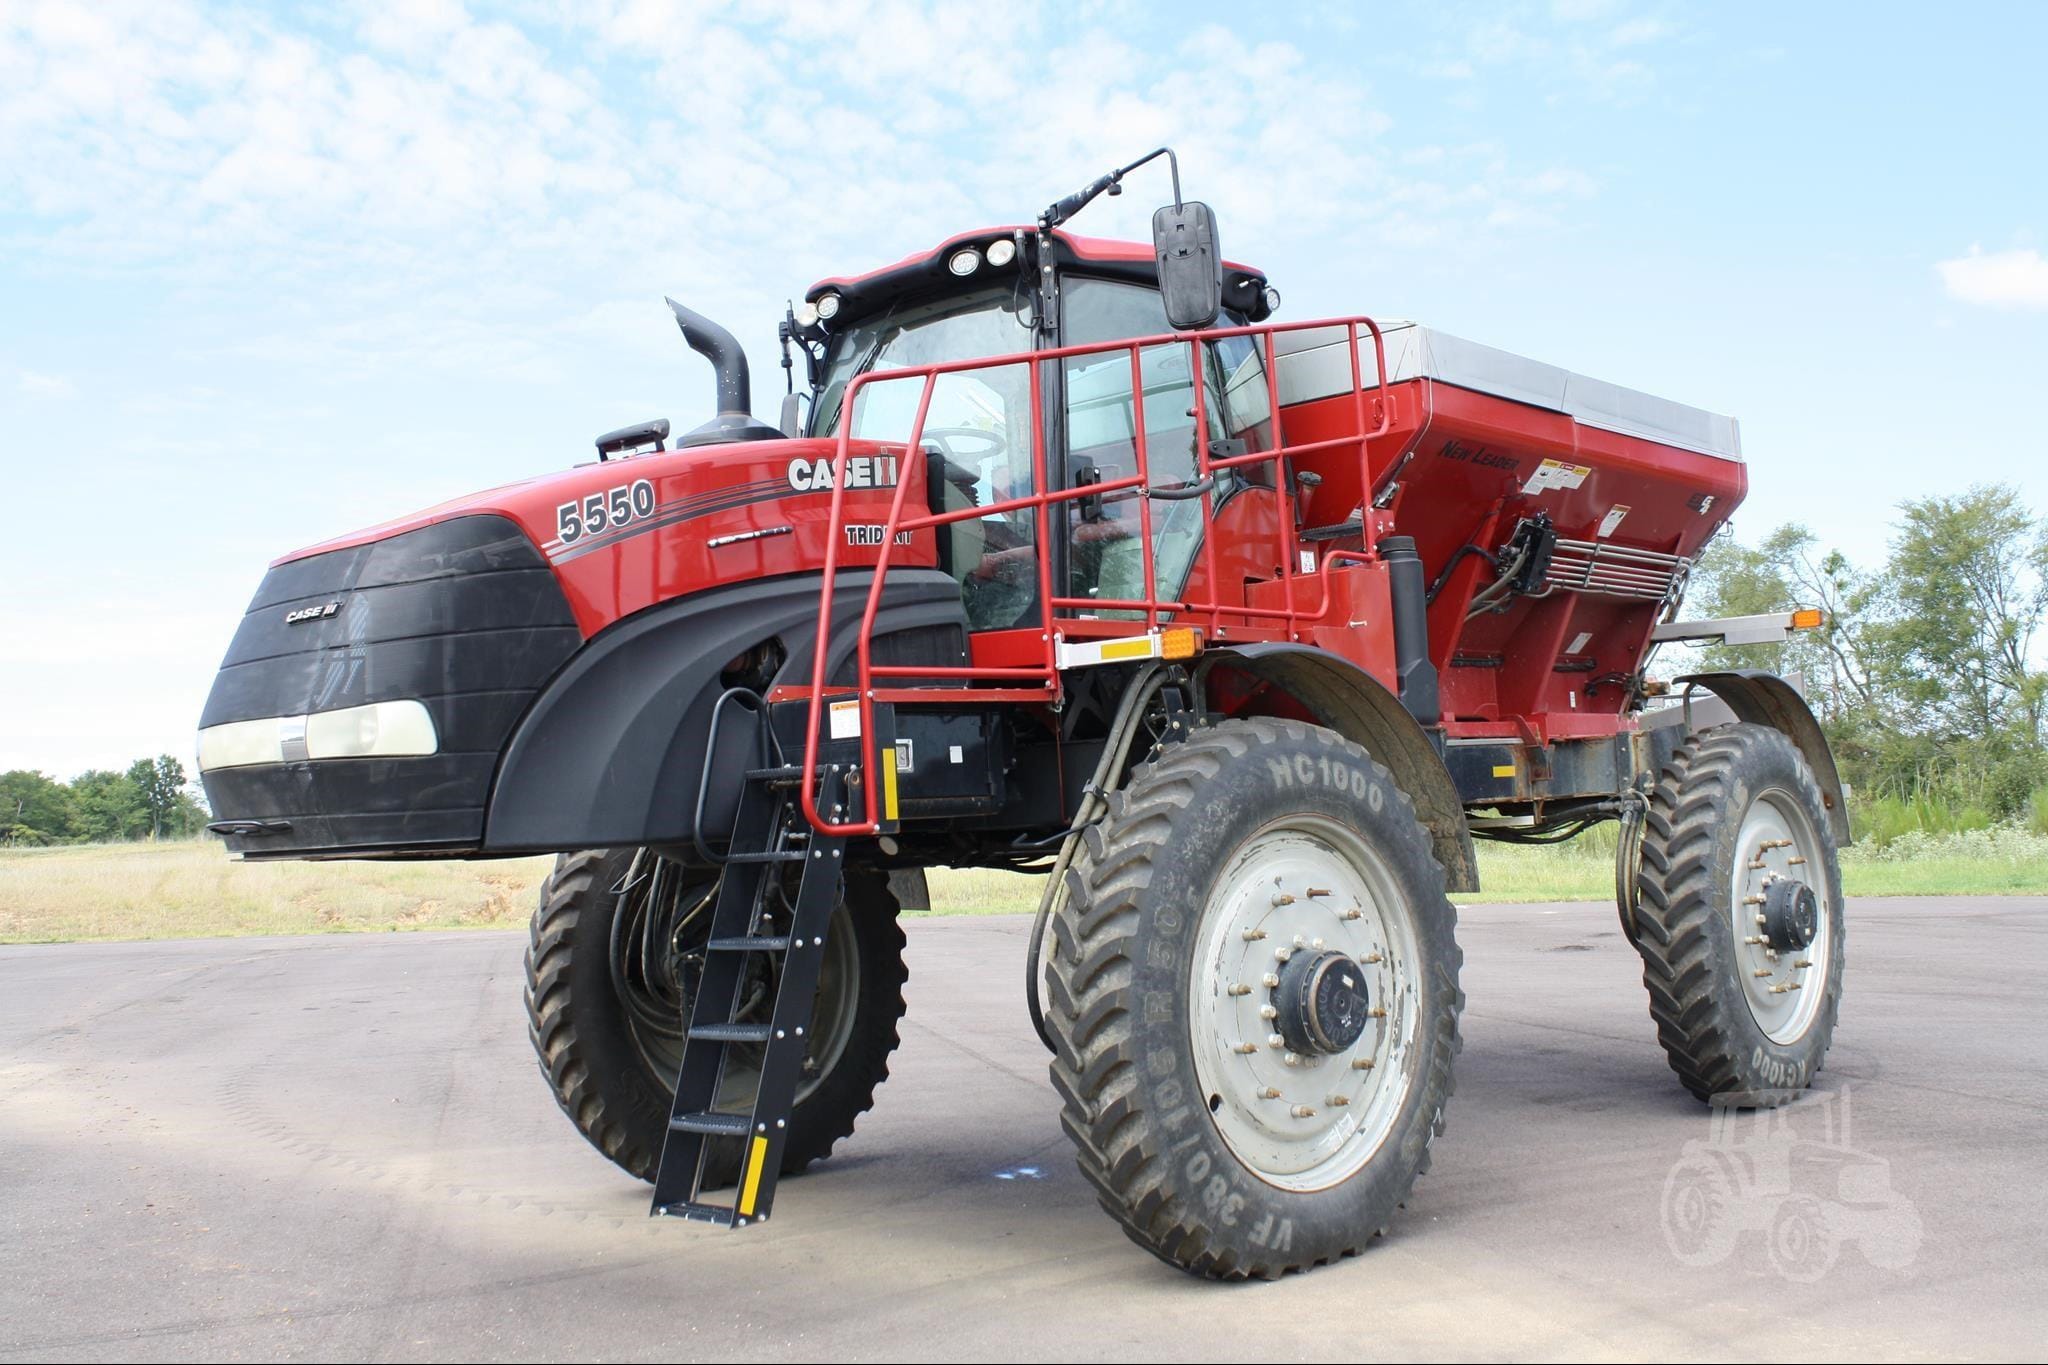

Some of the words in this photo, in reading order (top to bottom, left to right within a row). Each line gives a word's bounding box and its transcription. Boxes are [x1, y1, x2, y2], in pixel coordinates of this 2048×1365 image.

[557, 479, 656, 545] 5550
[845, 524, 913, 546] TRIDNT
[286, 606, 323, 623] CASE
[1265, 751, 1384, 813] HC1000
[1249, 1213, 1293, 1252] VF
